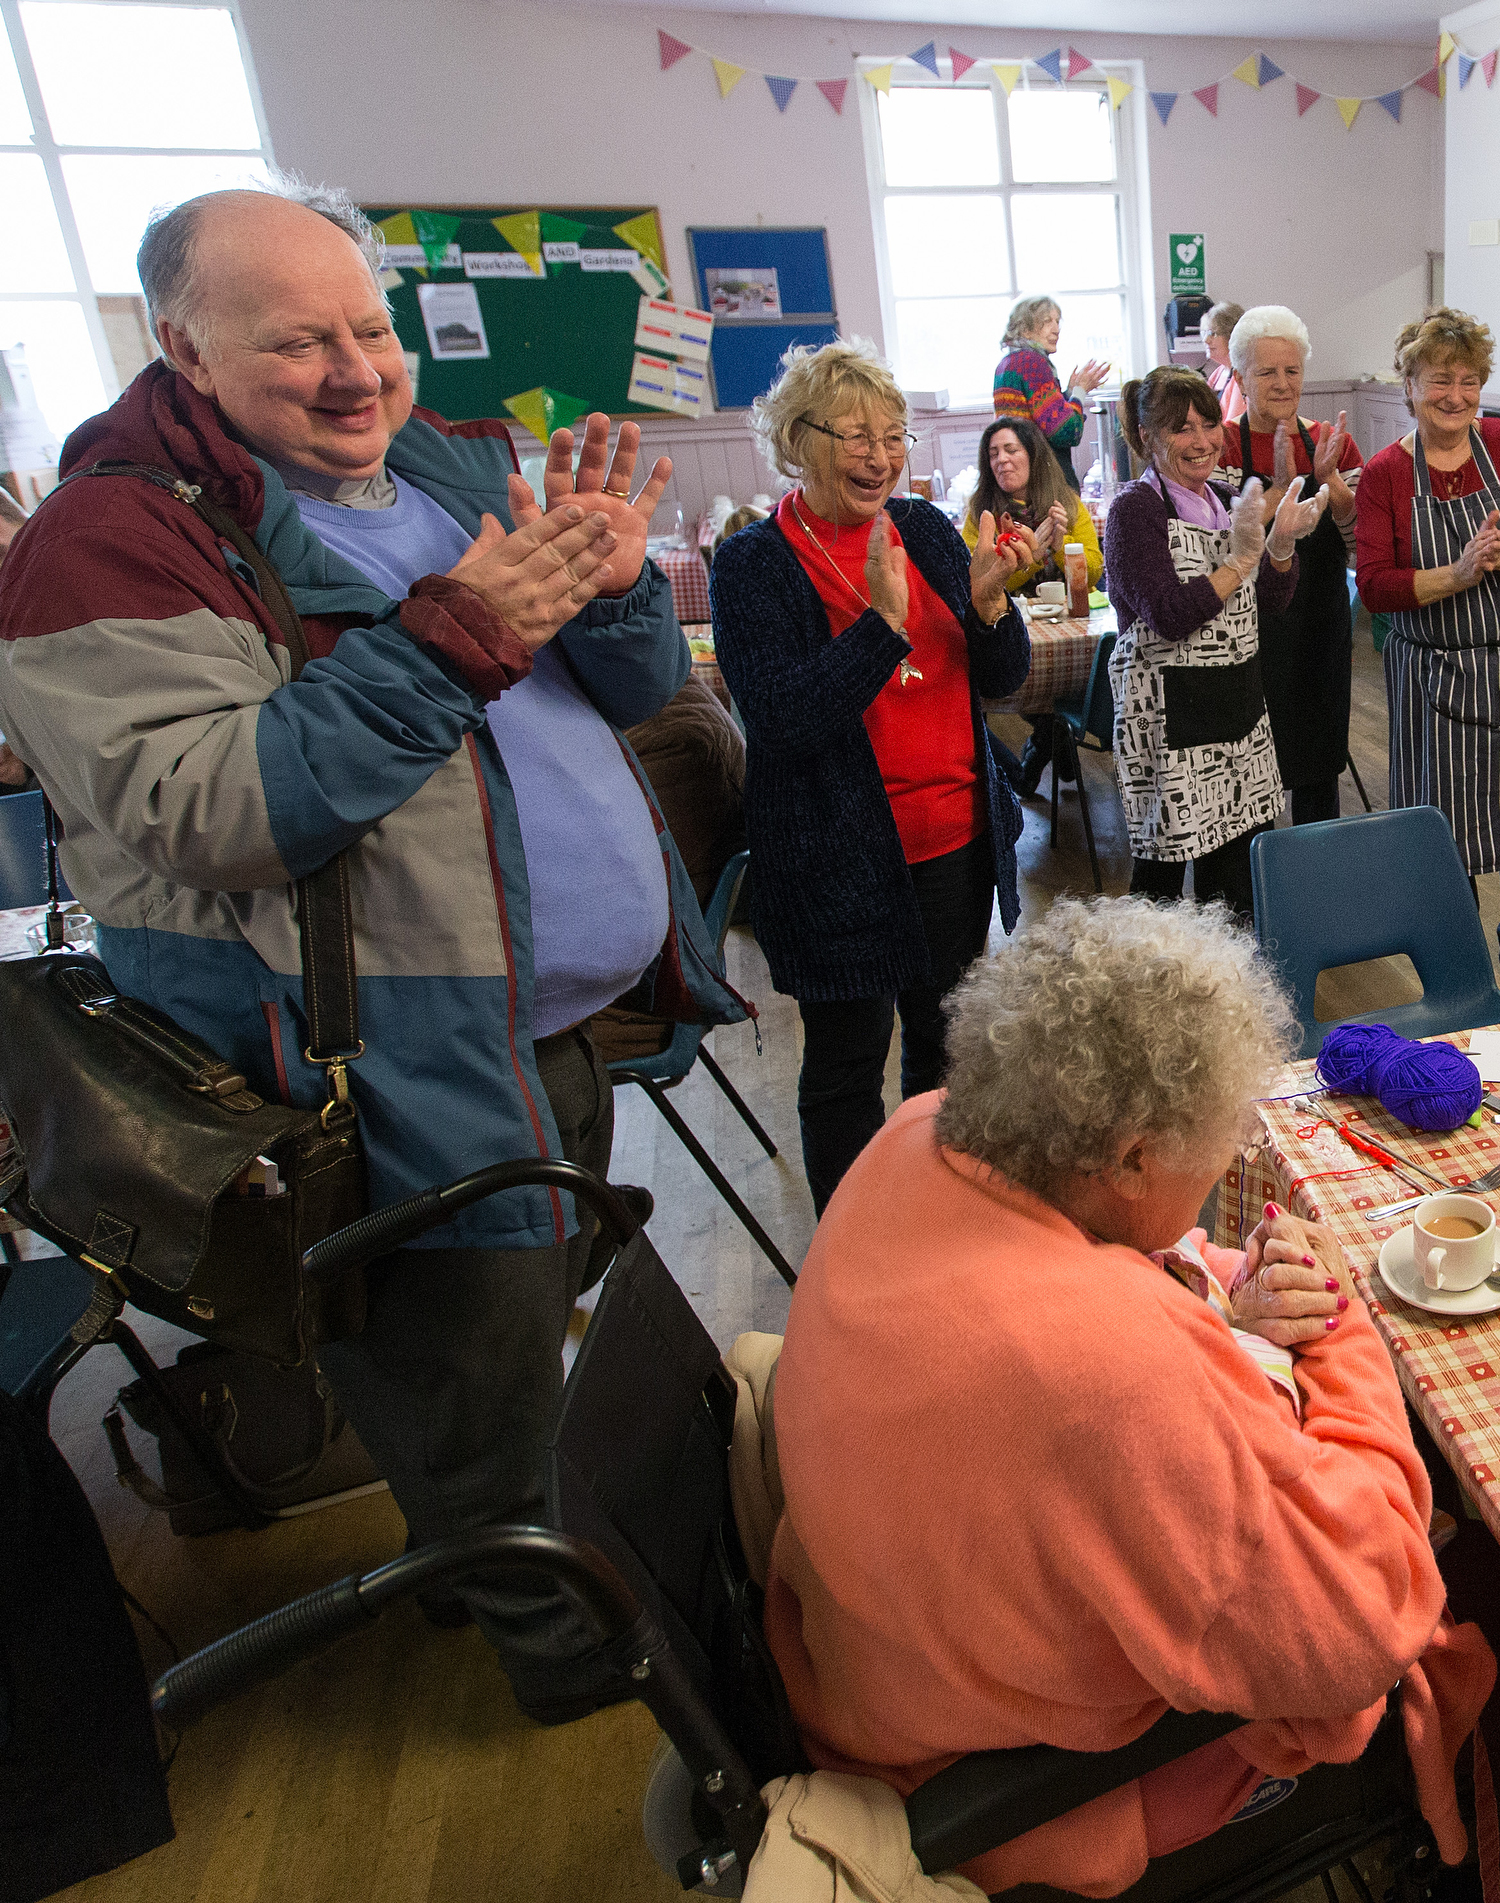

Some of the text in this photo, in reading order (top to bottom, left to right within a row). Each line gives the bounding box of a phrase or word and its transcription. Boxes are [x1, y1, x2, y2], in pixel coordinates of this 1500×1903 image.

[547, 246, 575, 257] AND
[583, 254, 633, 265] Gardens
[1178, 267, 1199, 276] AED
